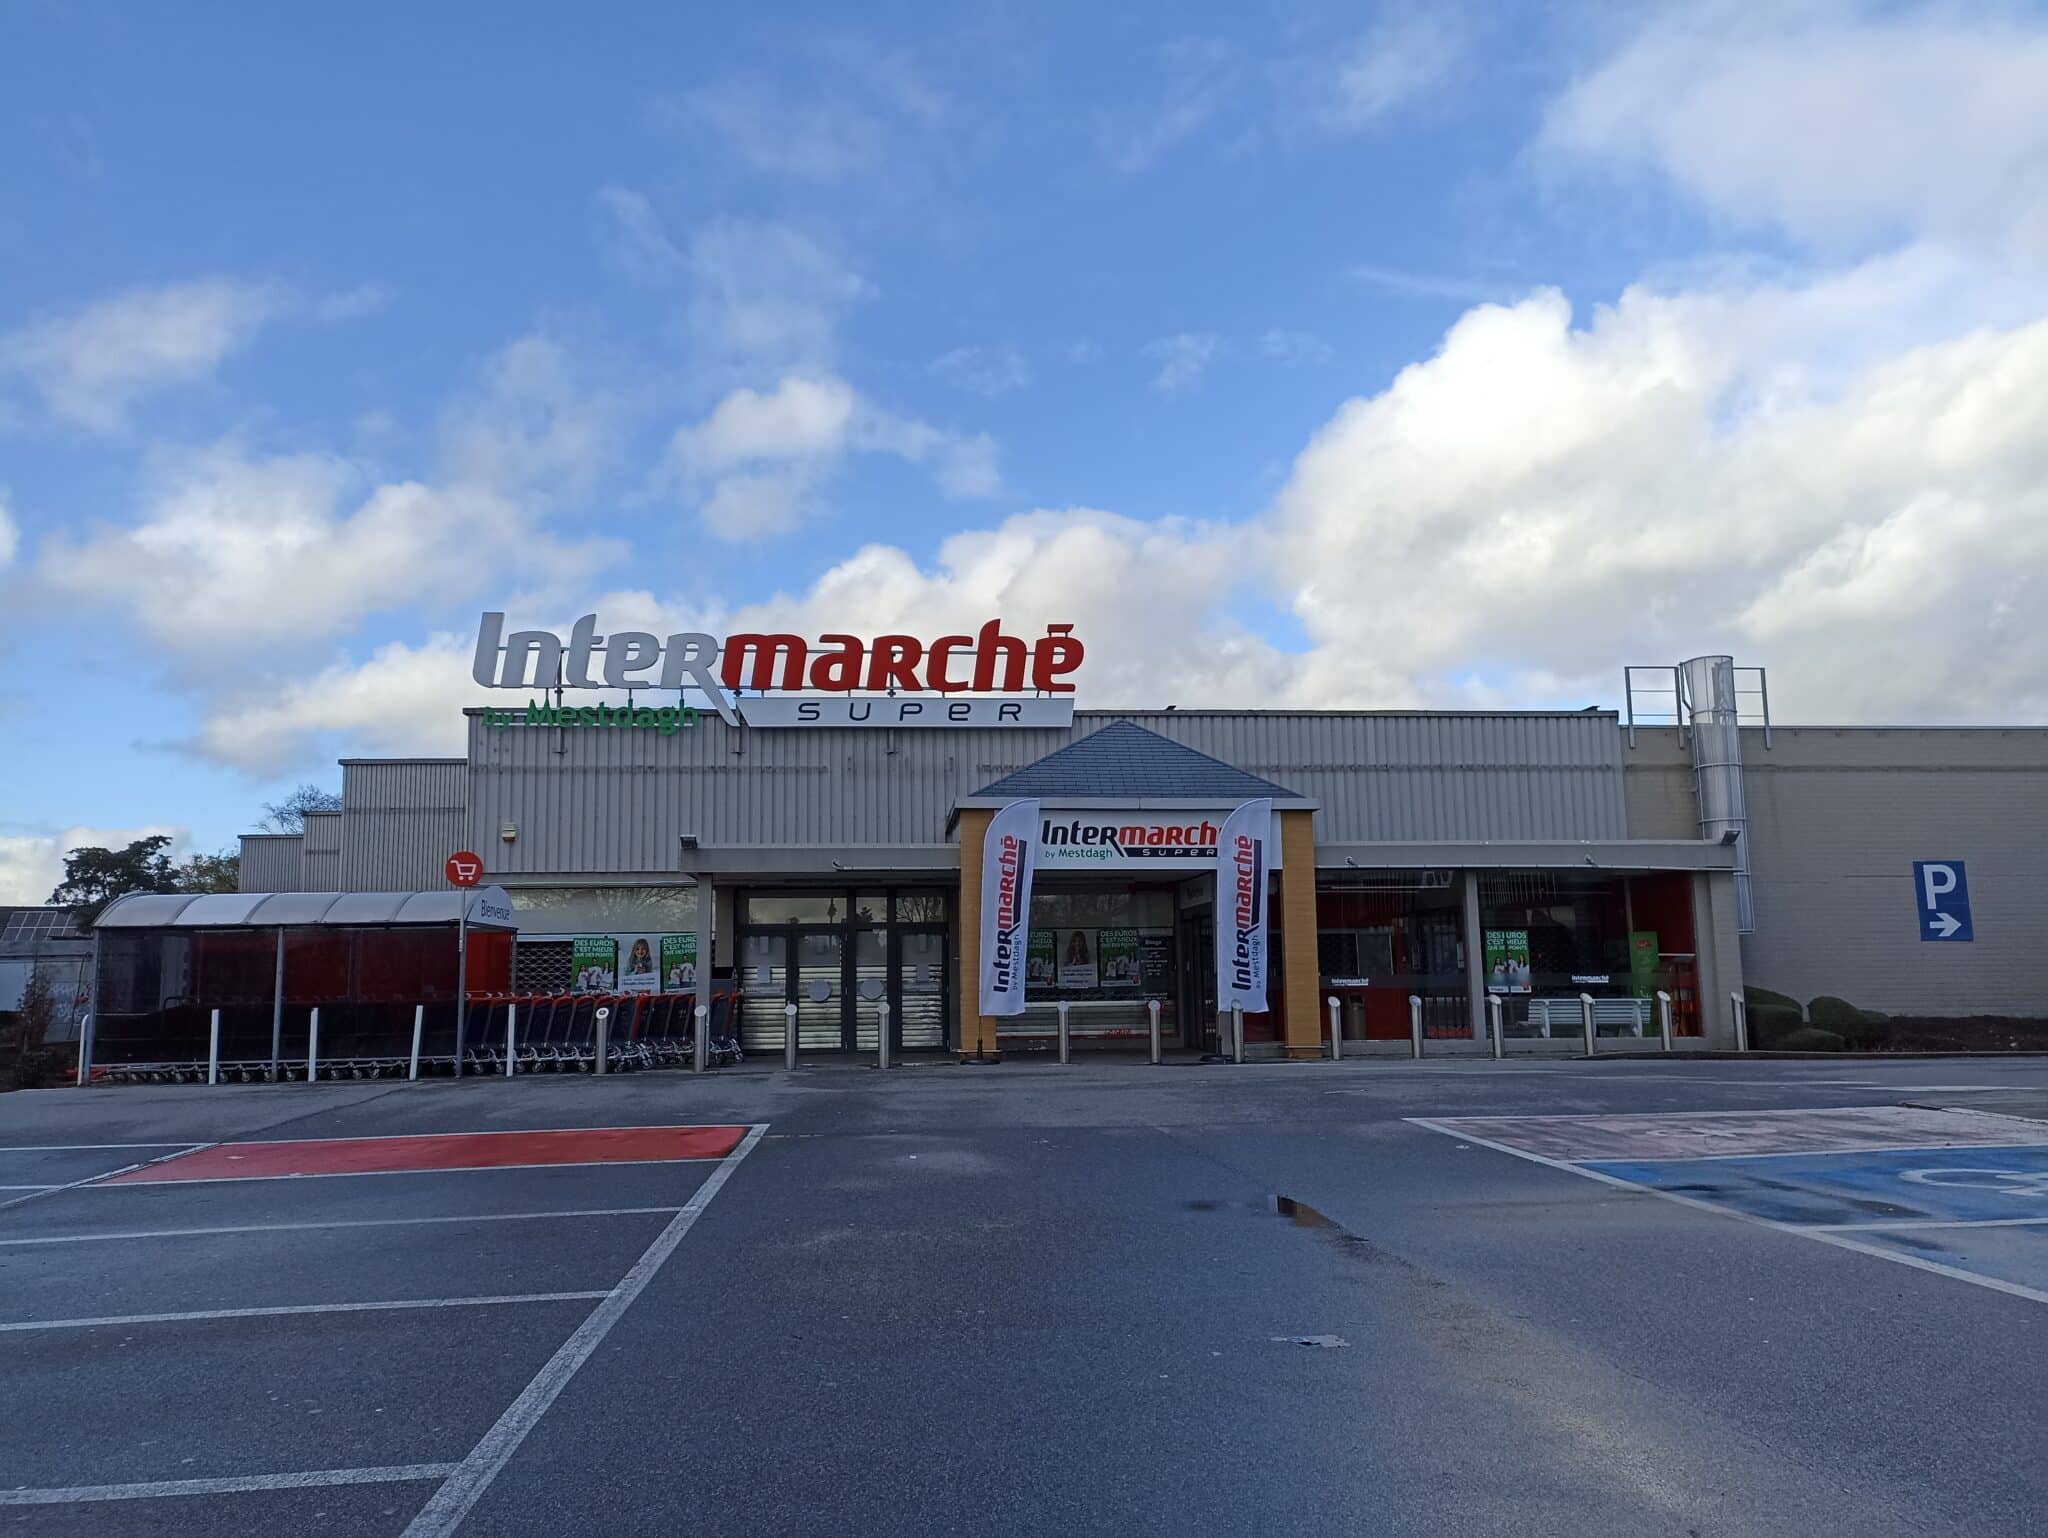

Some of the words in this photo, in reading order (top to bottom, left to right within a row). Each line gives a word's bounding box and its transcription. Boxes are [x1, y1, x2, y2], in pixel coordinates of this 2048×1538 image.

[481, 706, 512, 732] by
[525, 698, 699, 736] Mestdagh
[1041, 819, 1222, 858] Intermarch
[1045, 850, 1055, 859] by
[1058, 847, 1113, 861] Mestdagh
[1923, 864, 1956, 910] P
[574, 939, 588, 947] DES
[589, 939, 615, 947] EUROS
[1010, 934, 1022, 980] Mestdagh
[1251, 935, 1261, 978] Mestdagh
